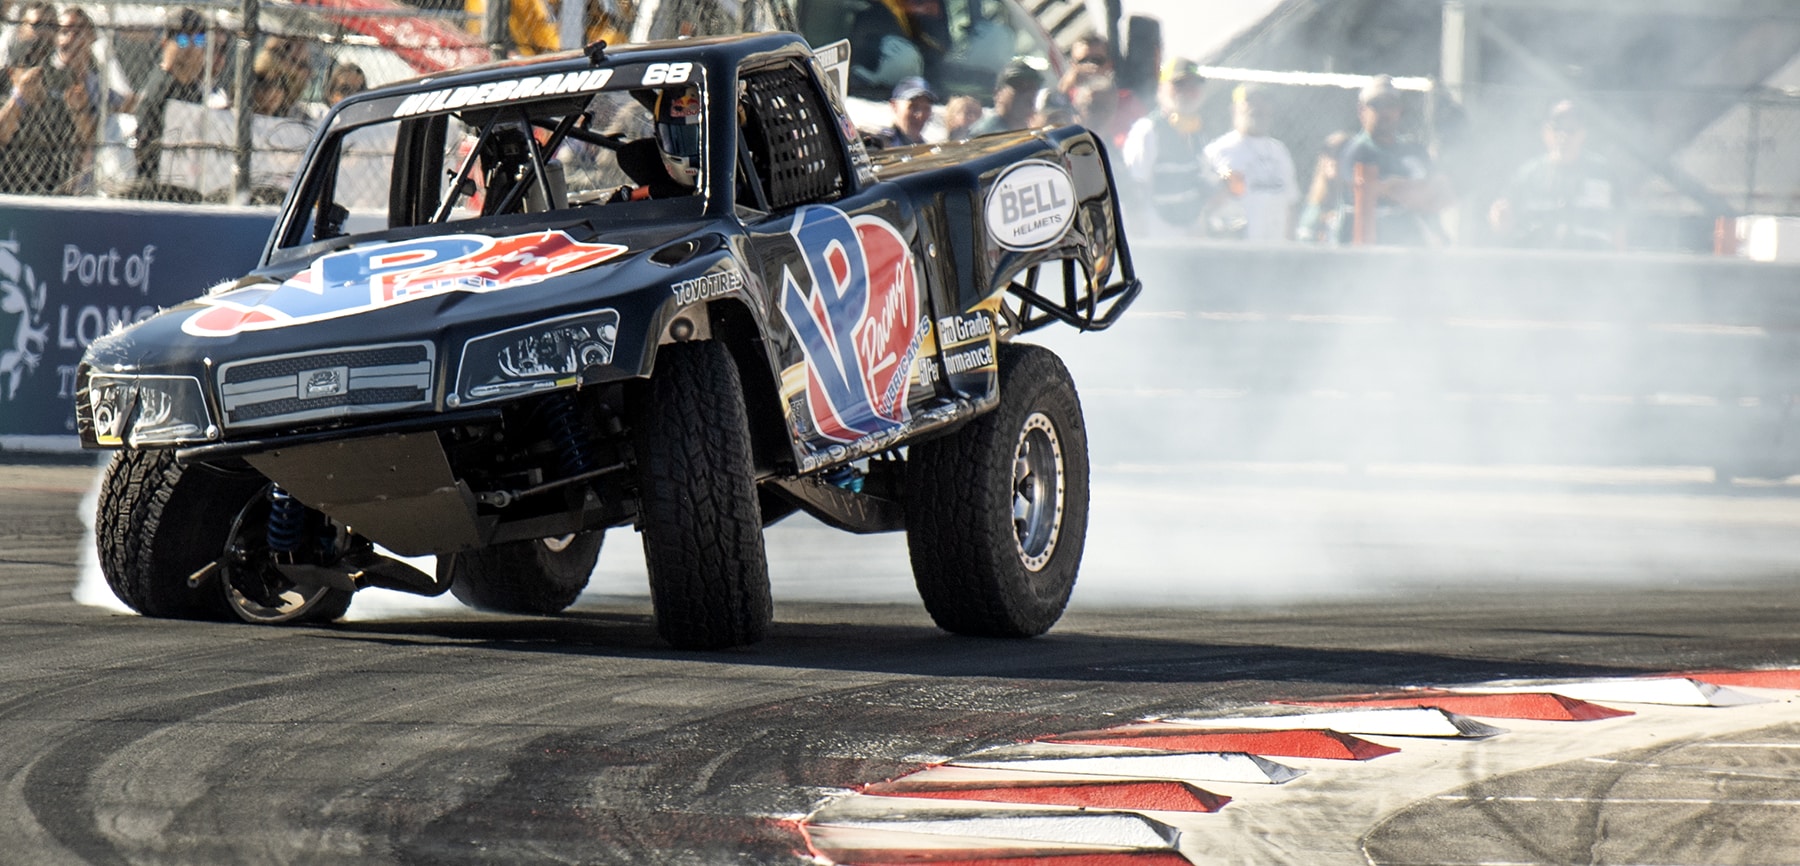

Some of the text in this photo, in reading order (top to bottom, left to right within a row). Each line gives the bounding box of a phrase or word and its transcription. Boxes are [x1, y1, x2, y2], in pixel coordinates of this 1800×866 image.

[393, 69, 614, 118] HILDEBRAND
[641, 62, 694, 86] 68
[1000, 179, 1066, 225] BELL
[1013, 214, 1062, 237] HELMETS
[62, 244, 156, 295] Port of
[861, 258, 909, 404] Racing
[955, 311, 992, 340] Grade
[878, 314, 931, 418] LUBRICANTS
